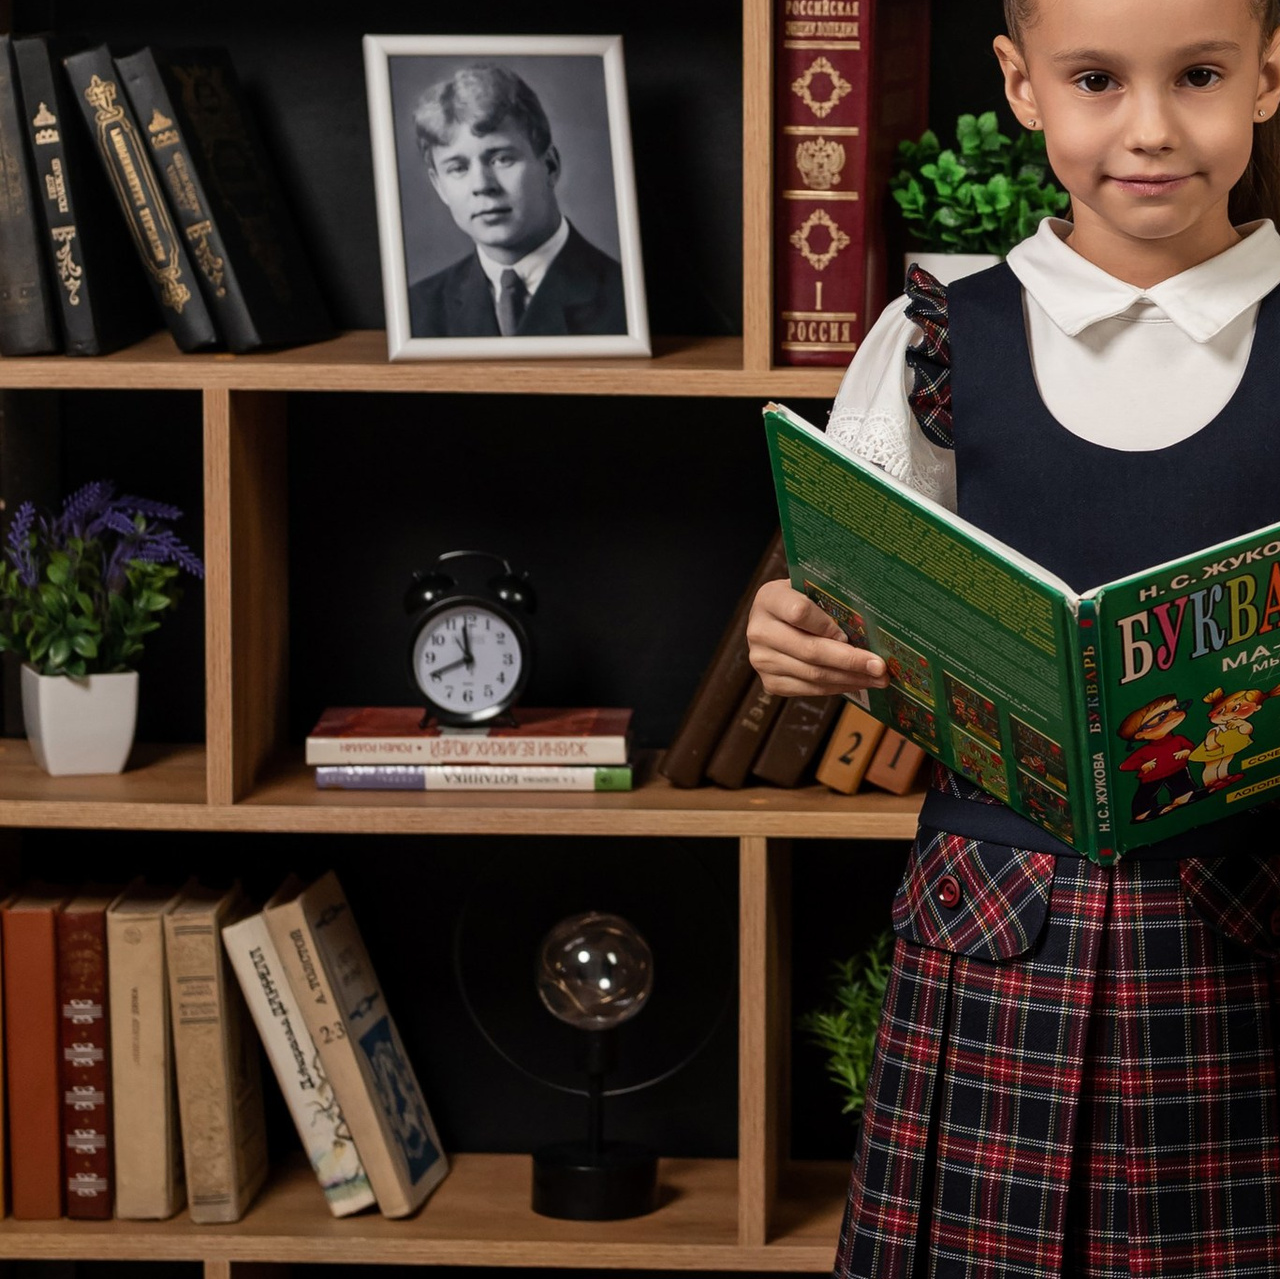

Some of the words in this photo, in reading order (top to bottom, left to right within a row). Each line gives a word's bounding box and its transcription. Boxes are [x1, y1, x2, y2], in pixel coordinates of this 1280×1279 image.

[786, 321, 851, 342] РОССИЯ
[1083, 644, 1102, 734] БУКВАРЬ
[838, 731, 863, 766] 2
[443, 773, 519, 785] БОТАНИКА
[1092, 752, 1107, 805] ЖУКОВА
